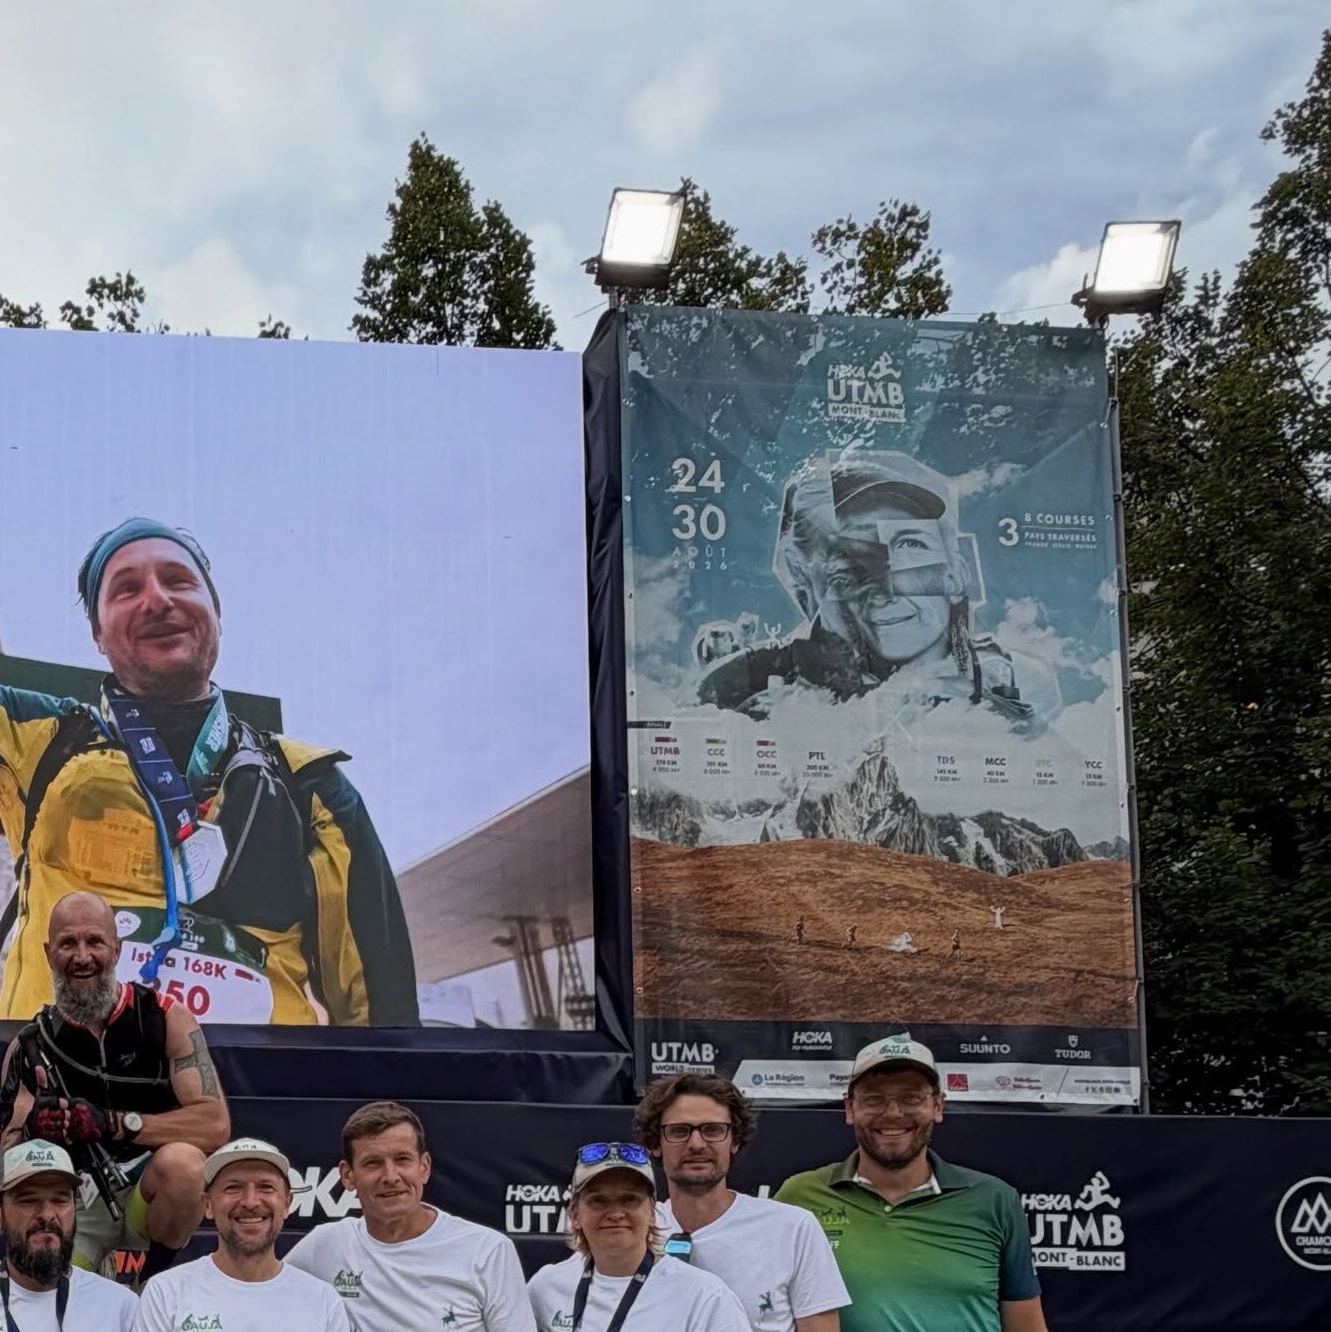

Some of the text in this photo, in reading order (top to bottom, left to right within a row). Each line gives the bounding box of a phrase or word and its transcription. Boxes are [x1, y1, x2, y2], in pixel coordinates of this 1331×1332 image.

[827, 379, 904, 406] UTMB
[671, 458, 725, 493] 24
[672, 504, 726, 541] 30
[1036, 513, 1095, 526] COURSES
[998, 517, 1019, 546] 3
[651, 746, 680, 755] UTMB
[707, 748, 725, 756] CCC
[756, 750, 777, 758] OCC
[808, 752, 826, 760] PTL
[937, 756, 955, 765] TDS
[985, 757, 1006, 766] MCC
[1084, 761, 1102, 769] YCC
[183, 957, 227, 980] 168K
[792, 1032, 832, 1044] HOKA
[651, 1042, 715, 1062] UTMB
[960, 1044, 1010, 1054] SUUNTO
[1055, 1049, 1091, 1060] TUDOR
[764, 1074, 805, 1083] La Région
[505, 1185, 559, 1201] HOKA
[1021, 1193, 1072, 1211] HOKA
[1296, 1236, 1331, 1246] CHAMO
